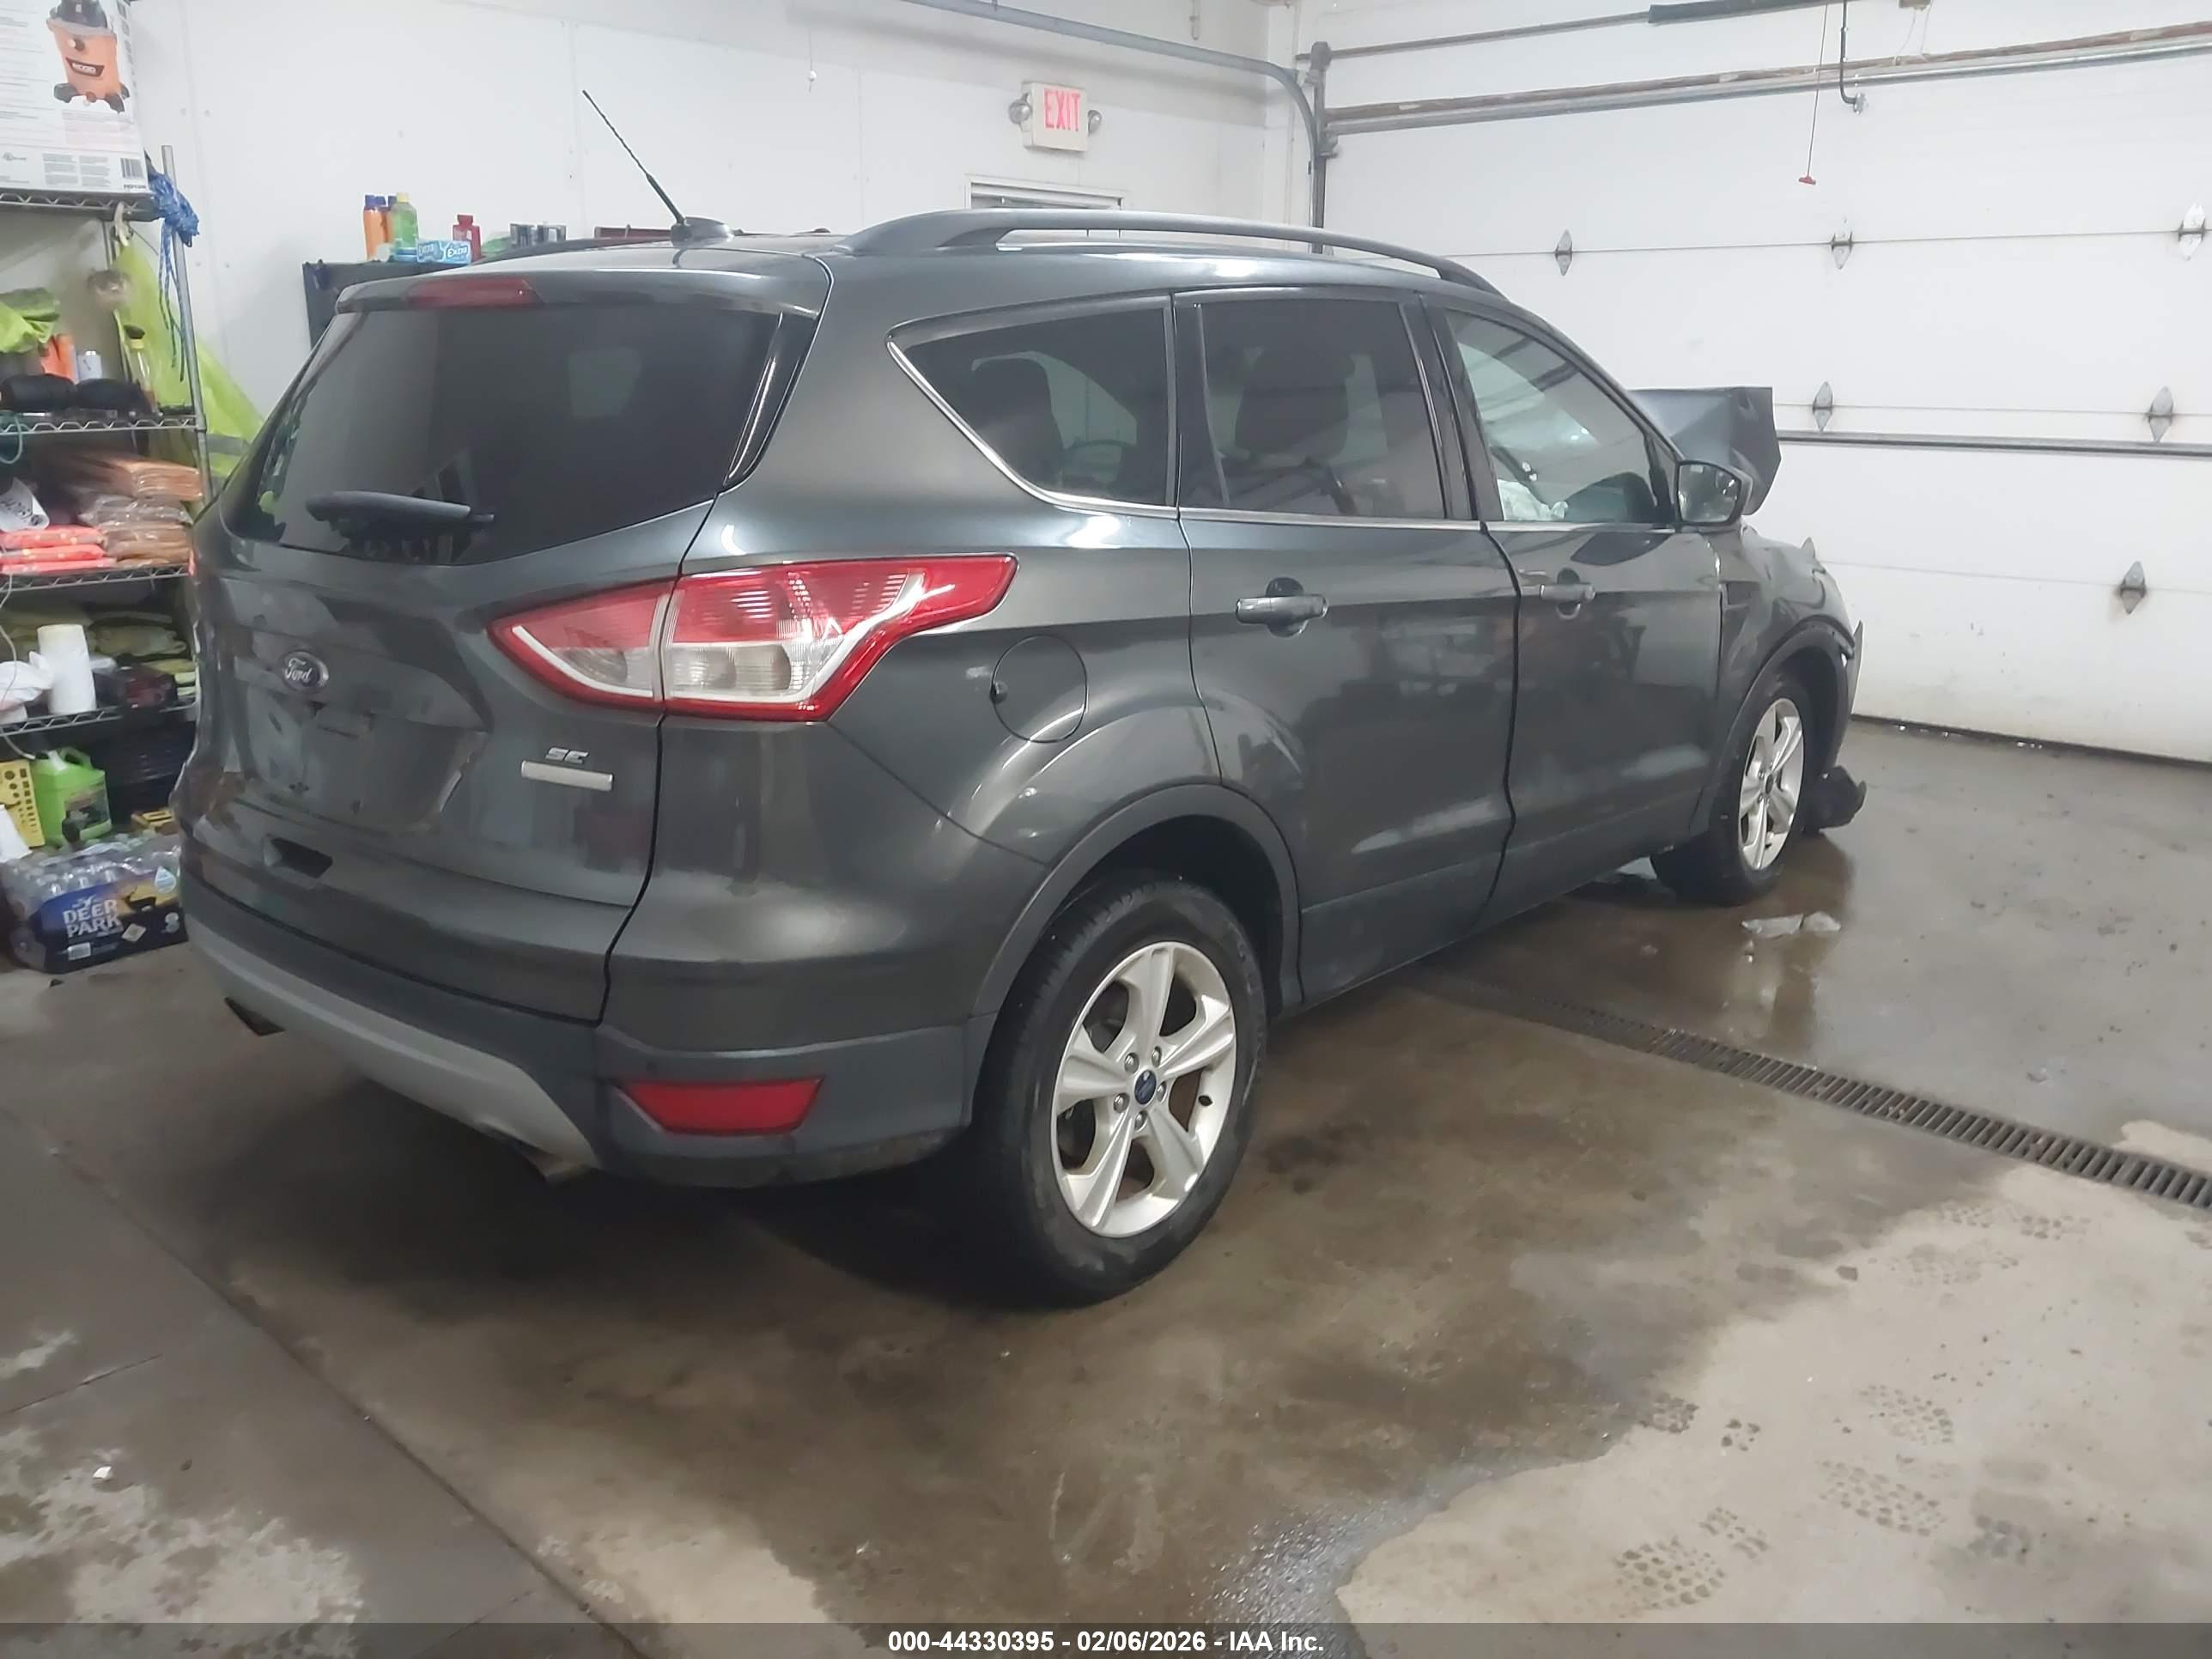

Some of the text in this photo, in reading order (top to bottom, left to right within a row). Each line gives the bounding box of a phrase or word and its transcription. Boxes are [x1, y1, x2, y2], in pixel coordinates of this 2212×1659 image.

[1044, 88, 1080, 131] EXIT
[284, 657, 313, 683] Ford
[544, 746, 589, 764] SE
[63, 899, 117, 924] DEER
[67, 914, 120, 938] PARK
